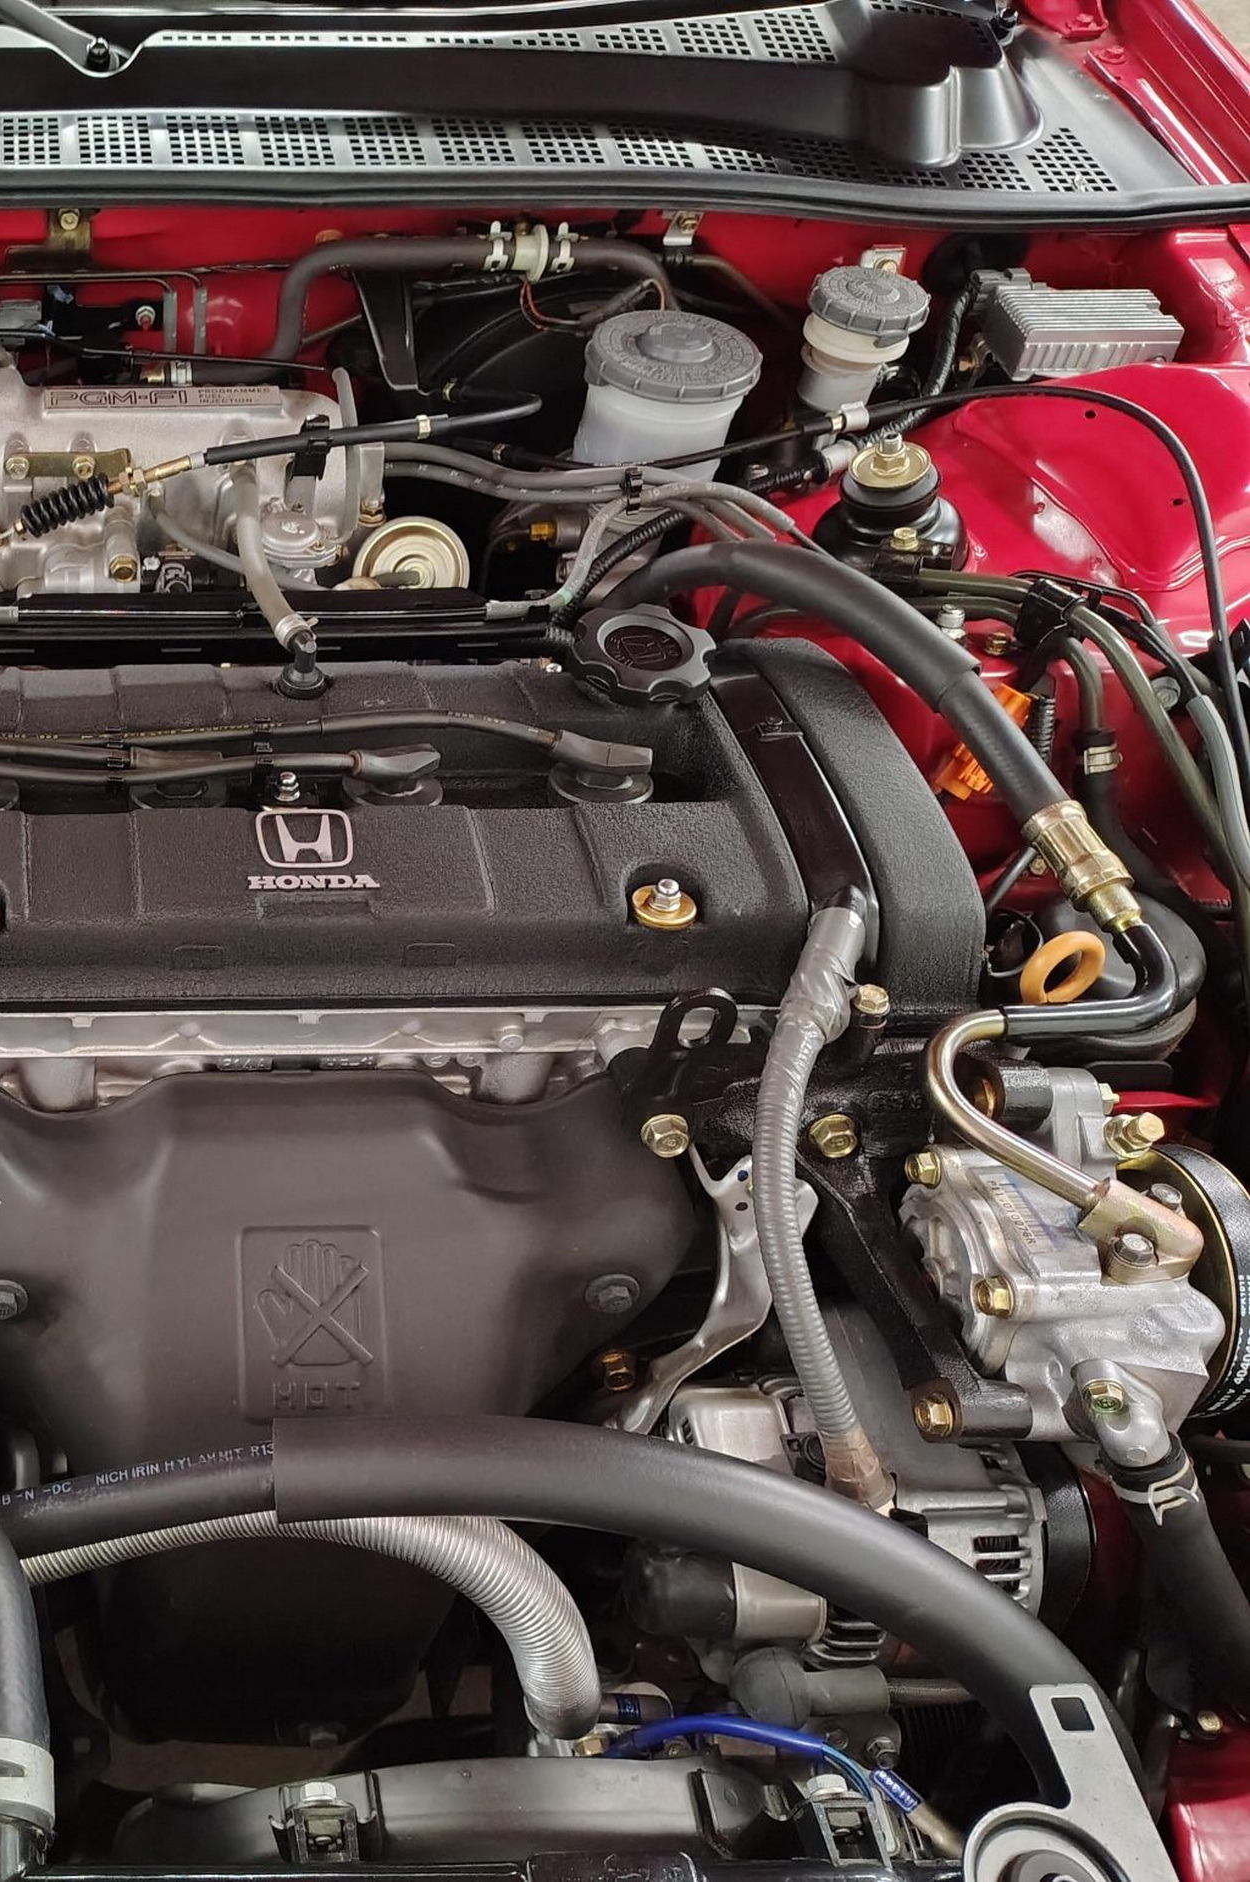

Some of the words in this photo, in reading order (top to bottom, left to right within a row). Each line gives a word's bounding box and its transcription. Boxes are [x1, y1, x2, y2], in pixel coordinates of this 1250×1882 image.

[50, 389, 188, 406] PGM-FI
[247, 874, 381, 890] HONDA
[273, 1382, 361, 1410] HOT
